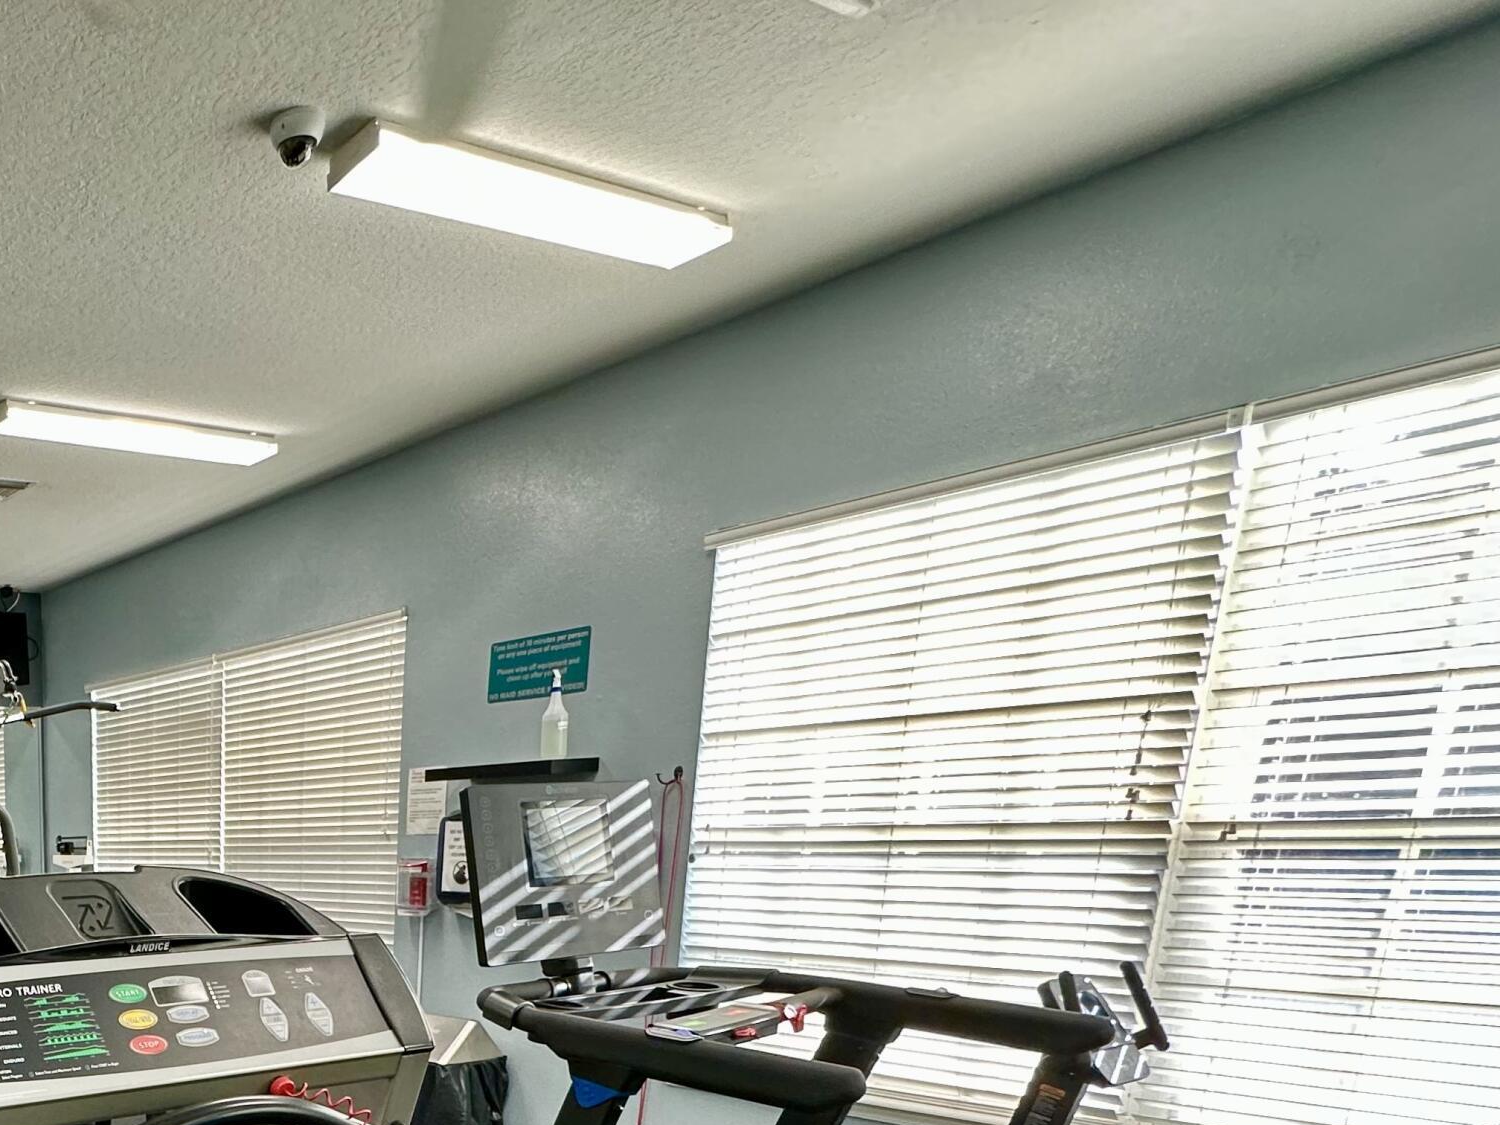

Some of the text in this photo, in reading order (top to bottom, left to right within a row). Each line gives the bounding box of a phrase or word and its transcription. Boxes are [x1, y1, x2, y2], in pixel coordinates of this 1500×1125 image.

[130, 941, 170, 953] LANDICE
[15, 983, 63, 996] TRAINER
[116, 989, 140, 998] START
[139, 1040, 160, 1049] STOP
